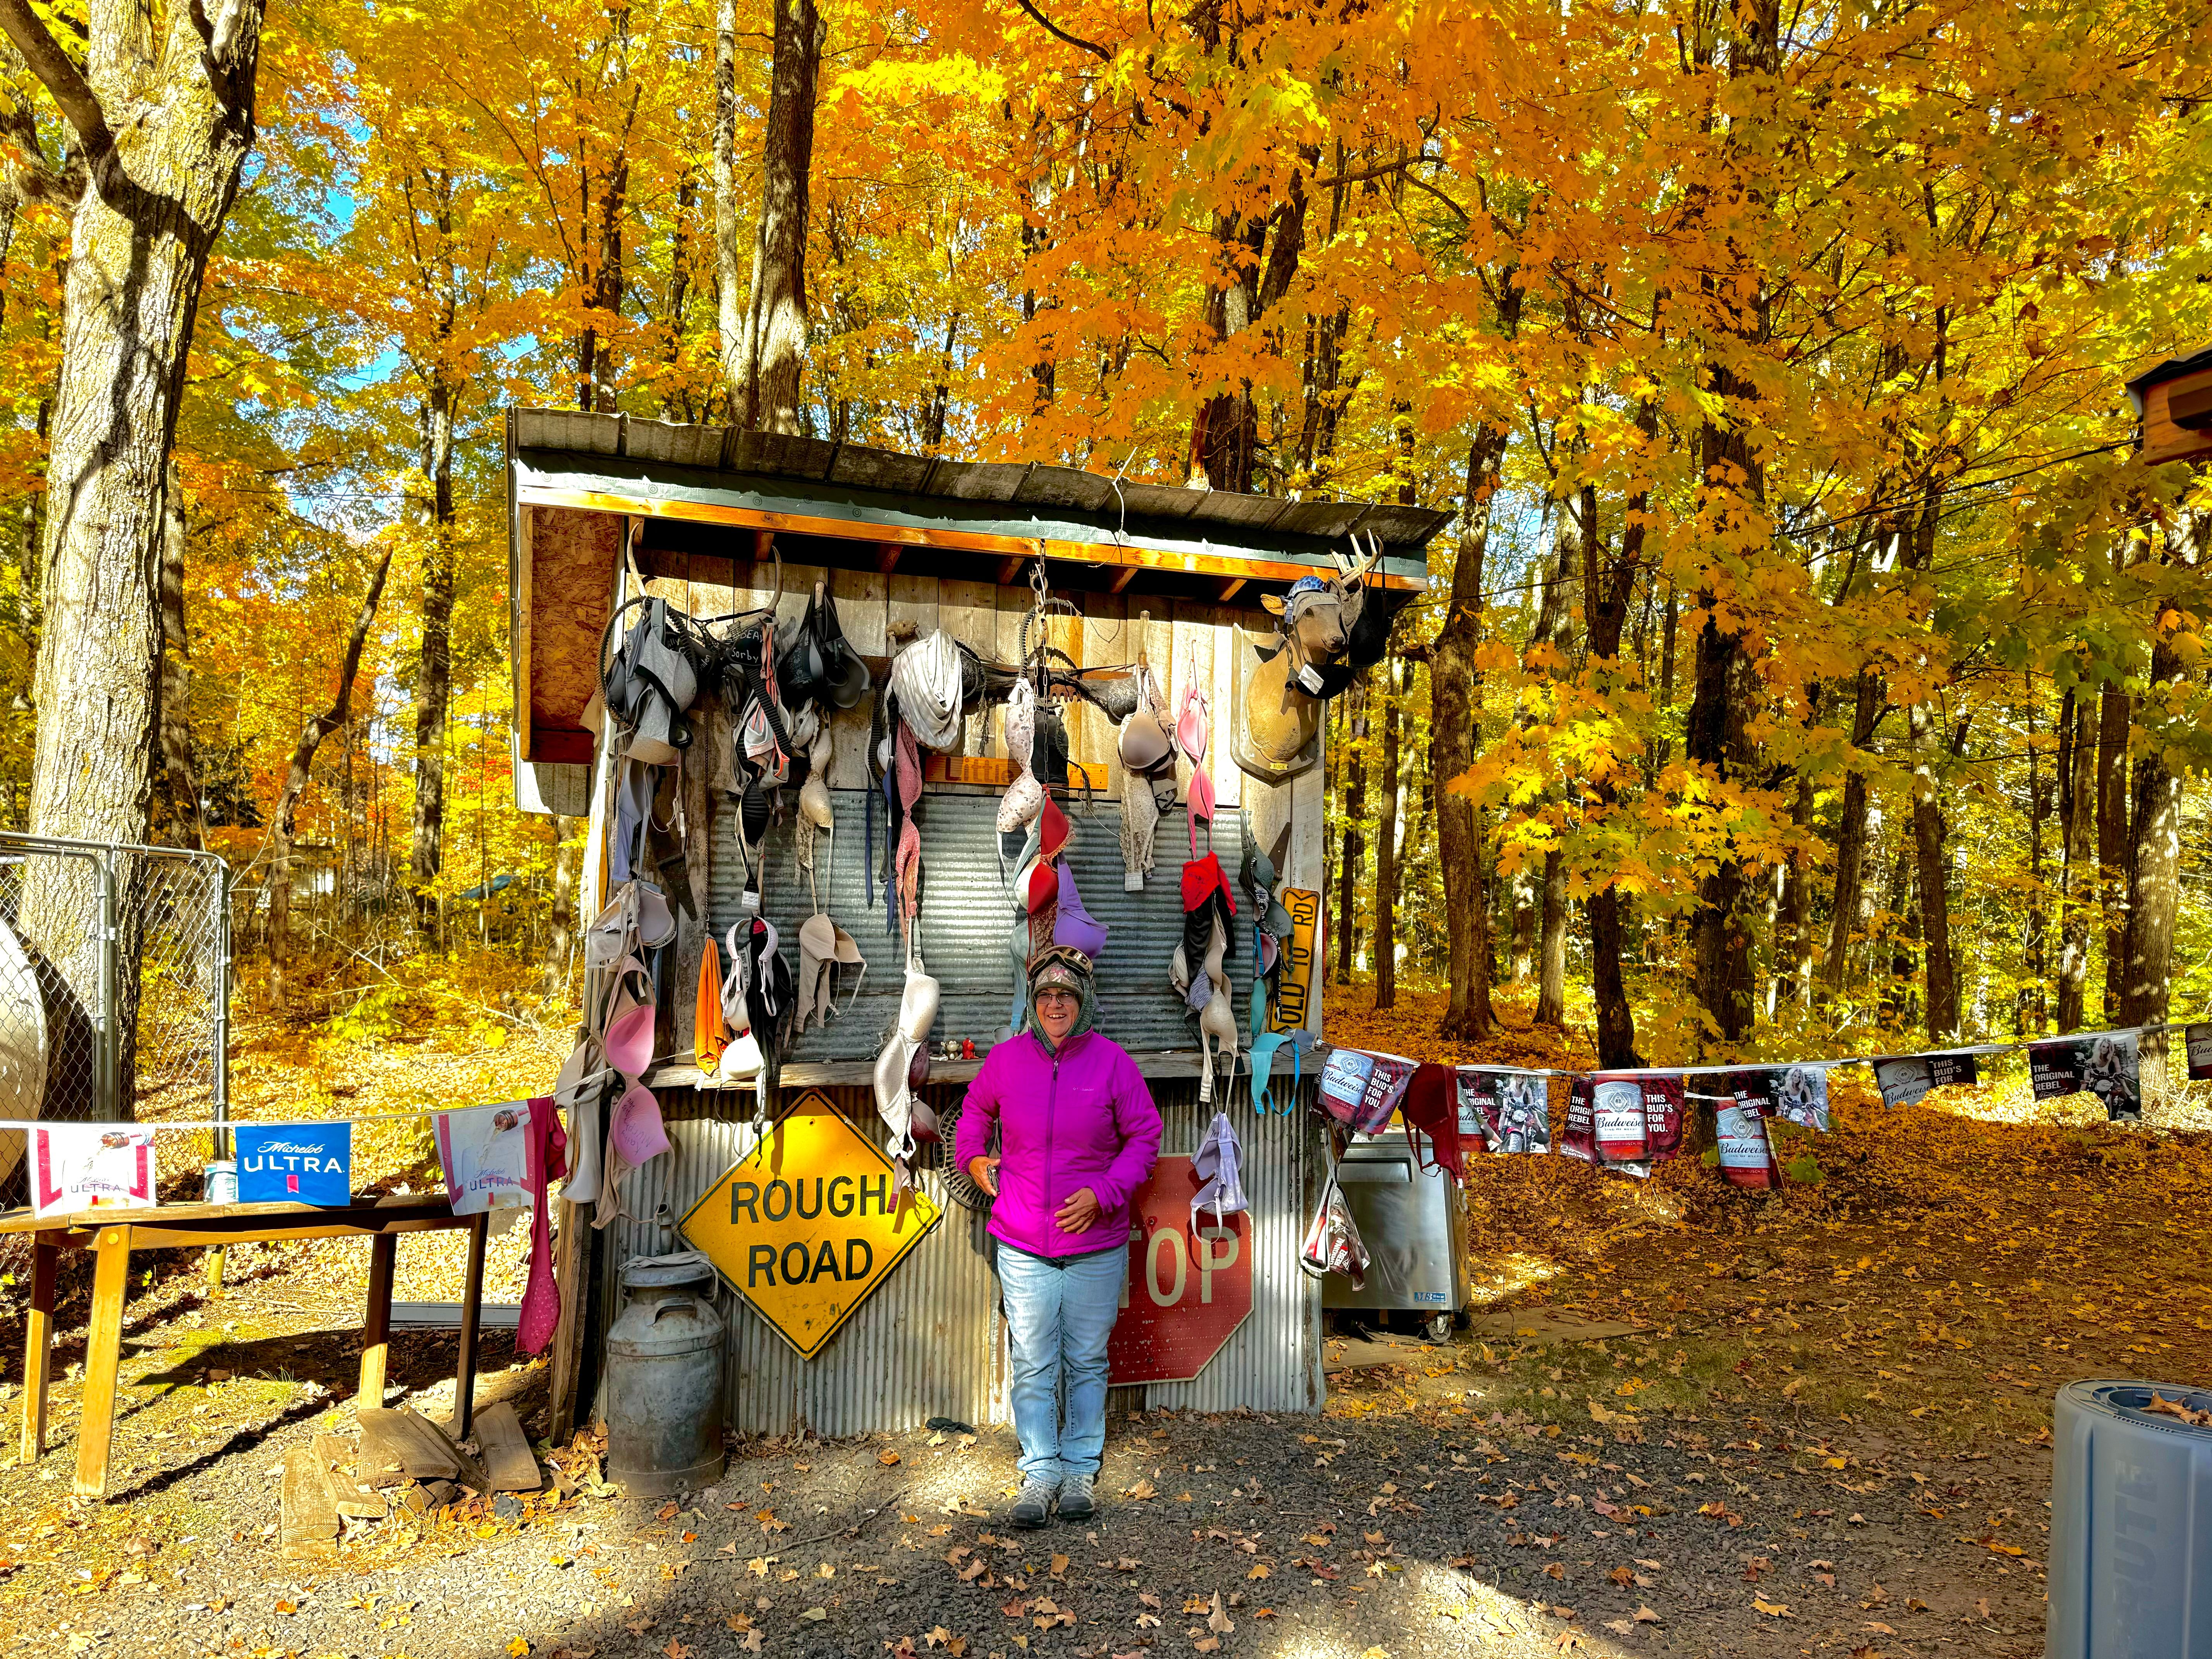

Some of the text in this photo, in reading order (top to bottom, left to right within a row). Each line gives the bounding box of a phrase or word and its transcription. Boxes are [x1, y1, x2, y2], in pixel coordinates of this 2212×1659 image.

[731, 647, 759, 663] Sorby
[945, 756, 1014, 783] Little
[1274, 982, 1305, 1024] OLD
[1292, 902, 1314, 926] RD
[1932, 1059, 1953, 1069] THIS
[2032, 1064, 2050, 1073] THE
[1374, 1068, 1392, 1083] THIS
[1934, 1065, 1962, 1077] BUD'S
[2034, 1071, 2075, 1082] ORIGINAL
[1322, 1069, 1364, 1094] Budweiser
[1370, 1077, 1395, 1094] BUD'S
[1935, 1075, 1953, 1085] FOR
[2035, 1080, 2061, 1092] REBEL
[1367, 1086, 1382, 1099] FOR
[1645, 1094, 1666, 1103] THIS
[1733, 1090, 1748, 1100] THE
[1884, 1084, 1931, 1105] Budweise
[1364, 1094, 1381, 1109] YOU.
[1468, 1097, 1496, 1106] RIGINAL
[1571, 1096, 1586, 1106] THE
[1738, 1097, 1771, 1109] ORIGINAL
[1570, 1105, 1594, 1116] ORIGIN
[1646, 1104, 1673, 1113] BUD'S
[1743, 1108, 1761, 1118] EBEL
[1568, 1113, 1590, 1125] REBEL
[1596, 1117, 1644, 1128] Budweiser
[1647, 1114, 1664, 1123] FOR
[1648, 1123, 1668, 1132] YOU.
[257, 1141, 326, 1154] Michelob
[1719, 1143, 1768, 1154] Budweiser
[474, 1168, 505, 1178] Michelob
[71, 1183, 121, 1193] ULTRA
[470, 1176, 514, 1191] ULTRA
[730, 1173, 888, 1225] ROUGH
[748, 1238, 874, 1288] ROAD
[1334, 1249, 1348, 1266] REBEL
[1118, 1226, 1240, 1309] TOP
